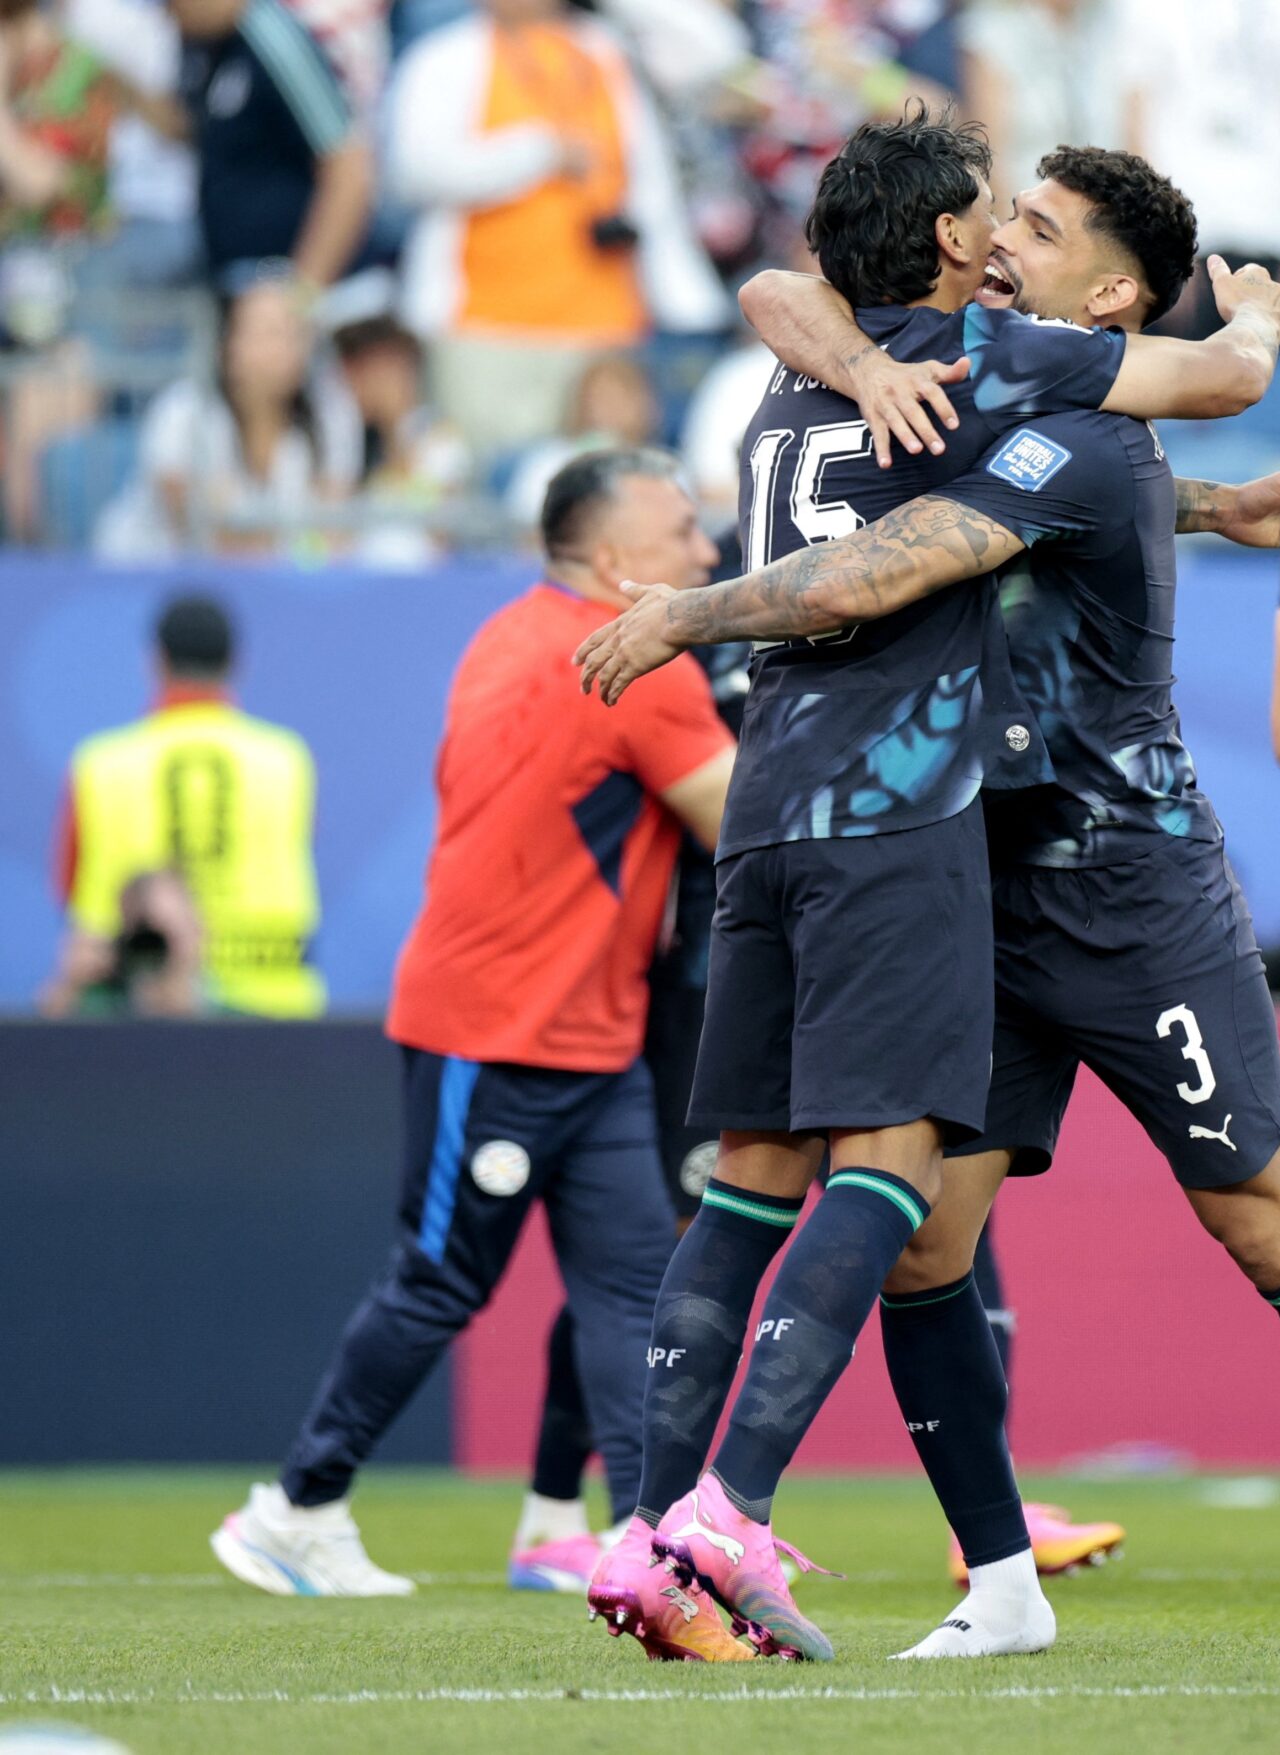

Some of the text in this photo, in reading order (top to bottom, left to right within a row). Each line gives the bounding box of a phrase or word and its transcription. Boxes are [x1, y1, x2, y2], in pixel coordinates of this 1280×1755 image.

[1012, 445, 1051, 471] UNITES
[747, 418, 873, 655] 15
[1155, 1003, 1216, 1104] 3
[755, 1318, 794, 1341] PF
[903, 1419, 940, 1433] PF
